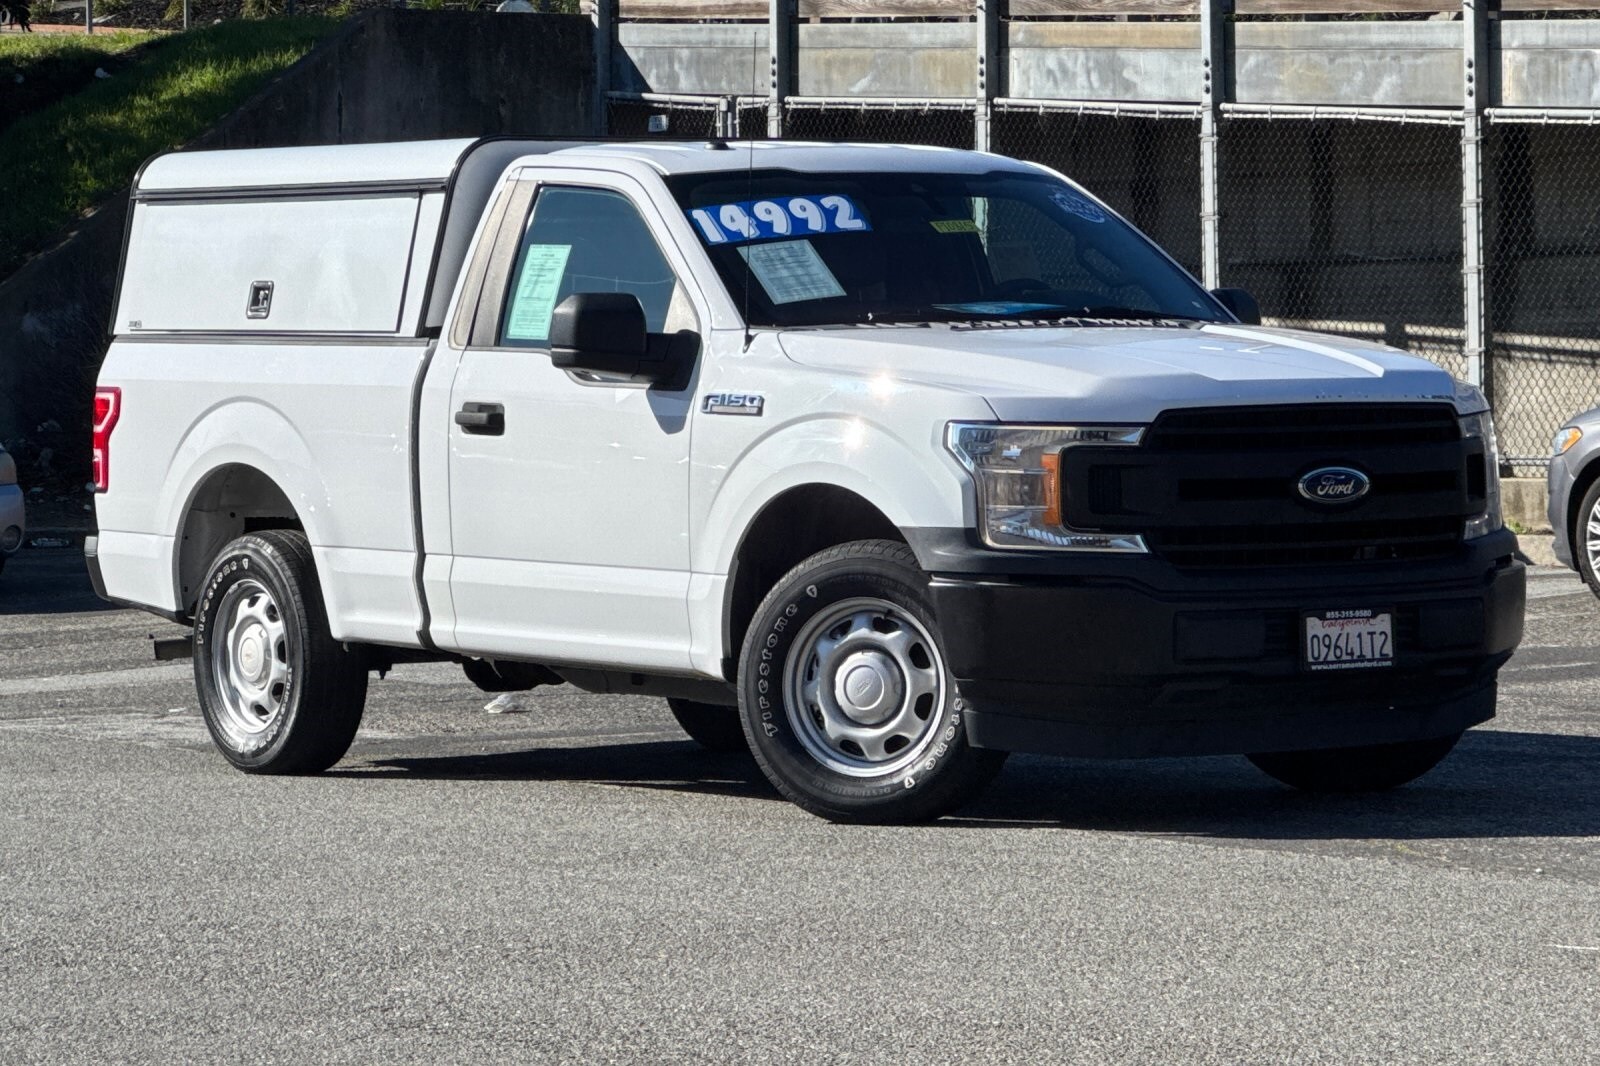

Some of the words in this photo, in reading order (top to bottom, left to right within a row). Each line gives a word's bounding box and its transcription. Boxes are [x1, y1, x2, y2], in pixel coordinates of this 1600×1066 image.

[691, 195, 866, 243] 14992
[1317, 474, 1355, 495] Ford
[1321, 618, 1372, 631] California
[1325, 609, 1372, 619] 855-315-9580
[1310, 631, 1390, 661] 09641T2
[758, 603, 798, 738] Firestone
